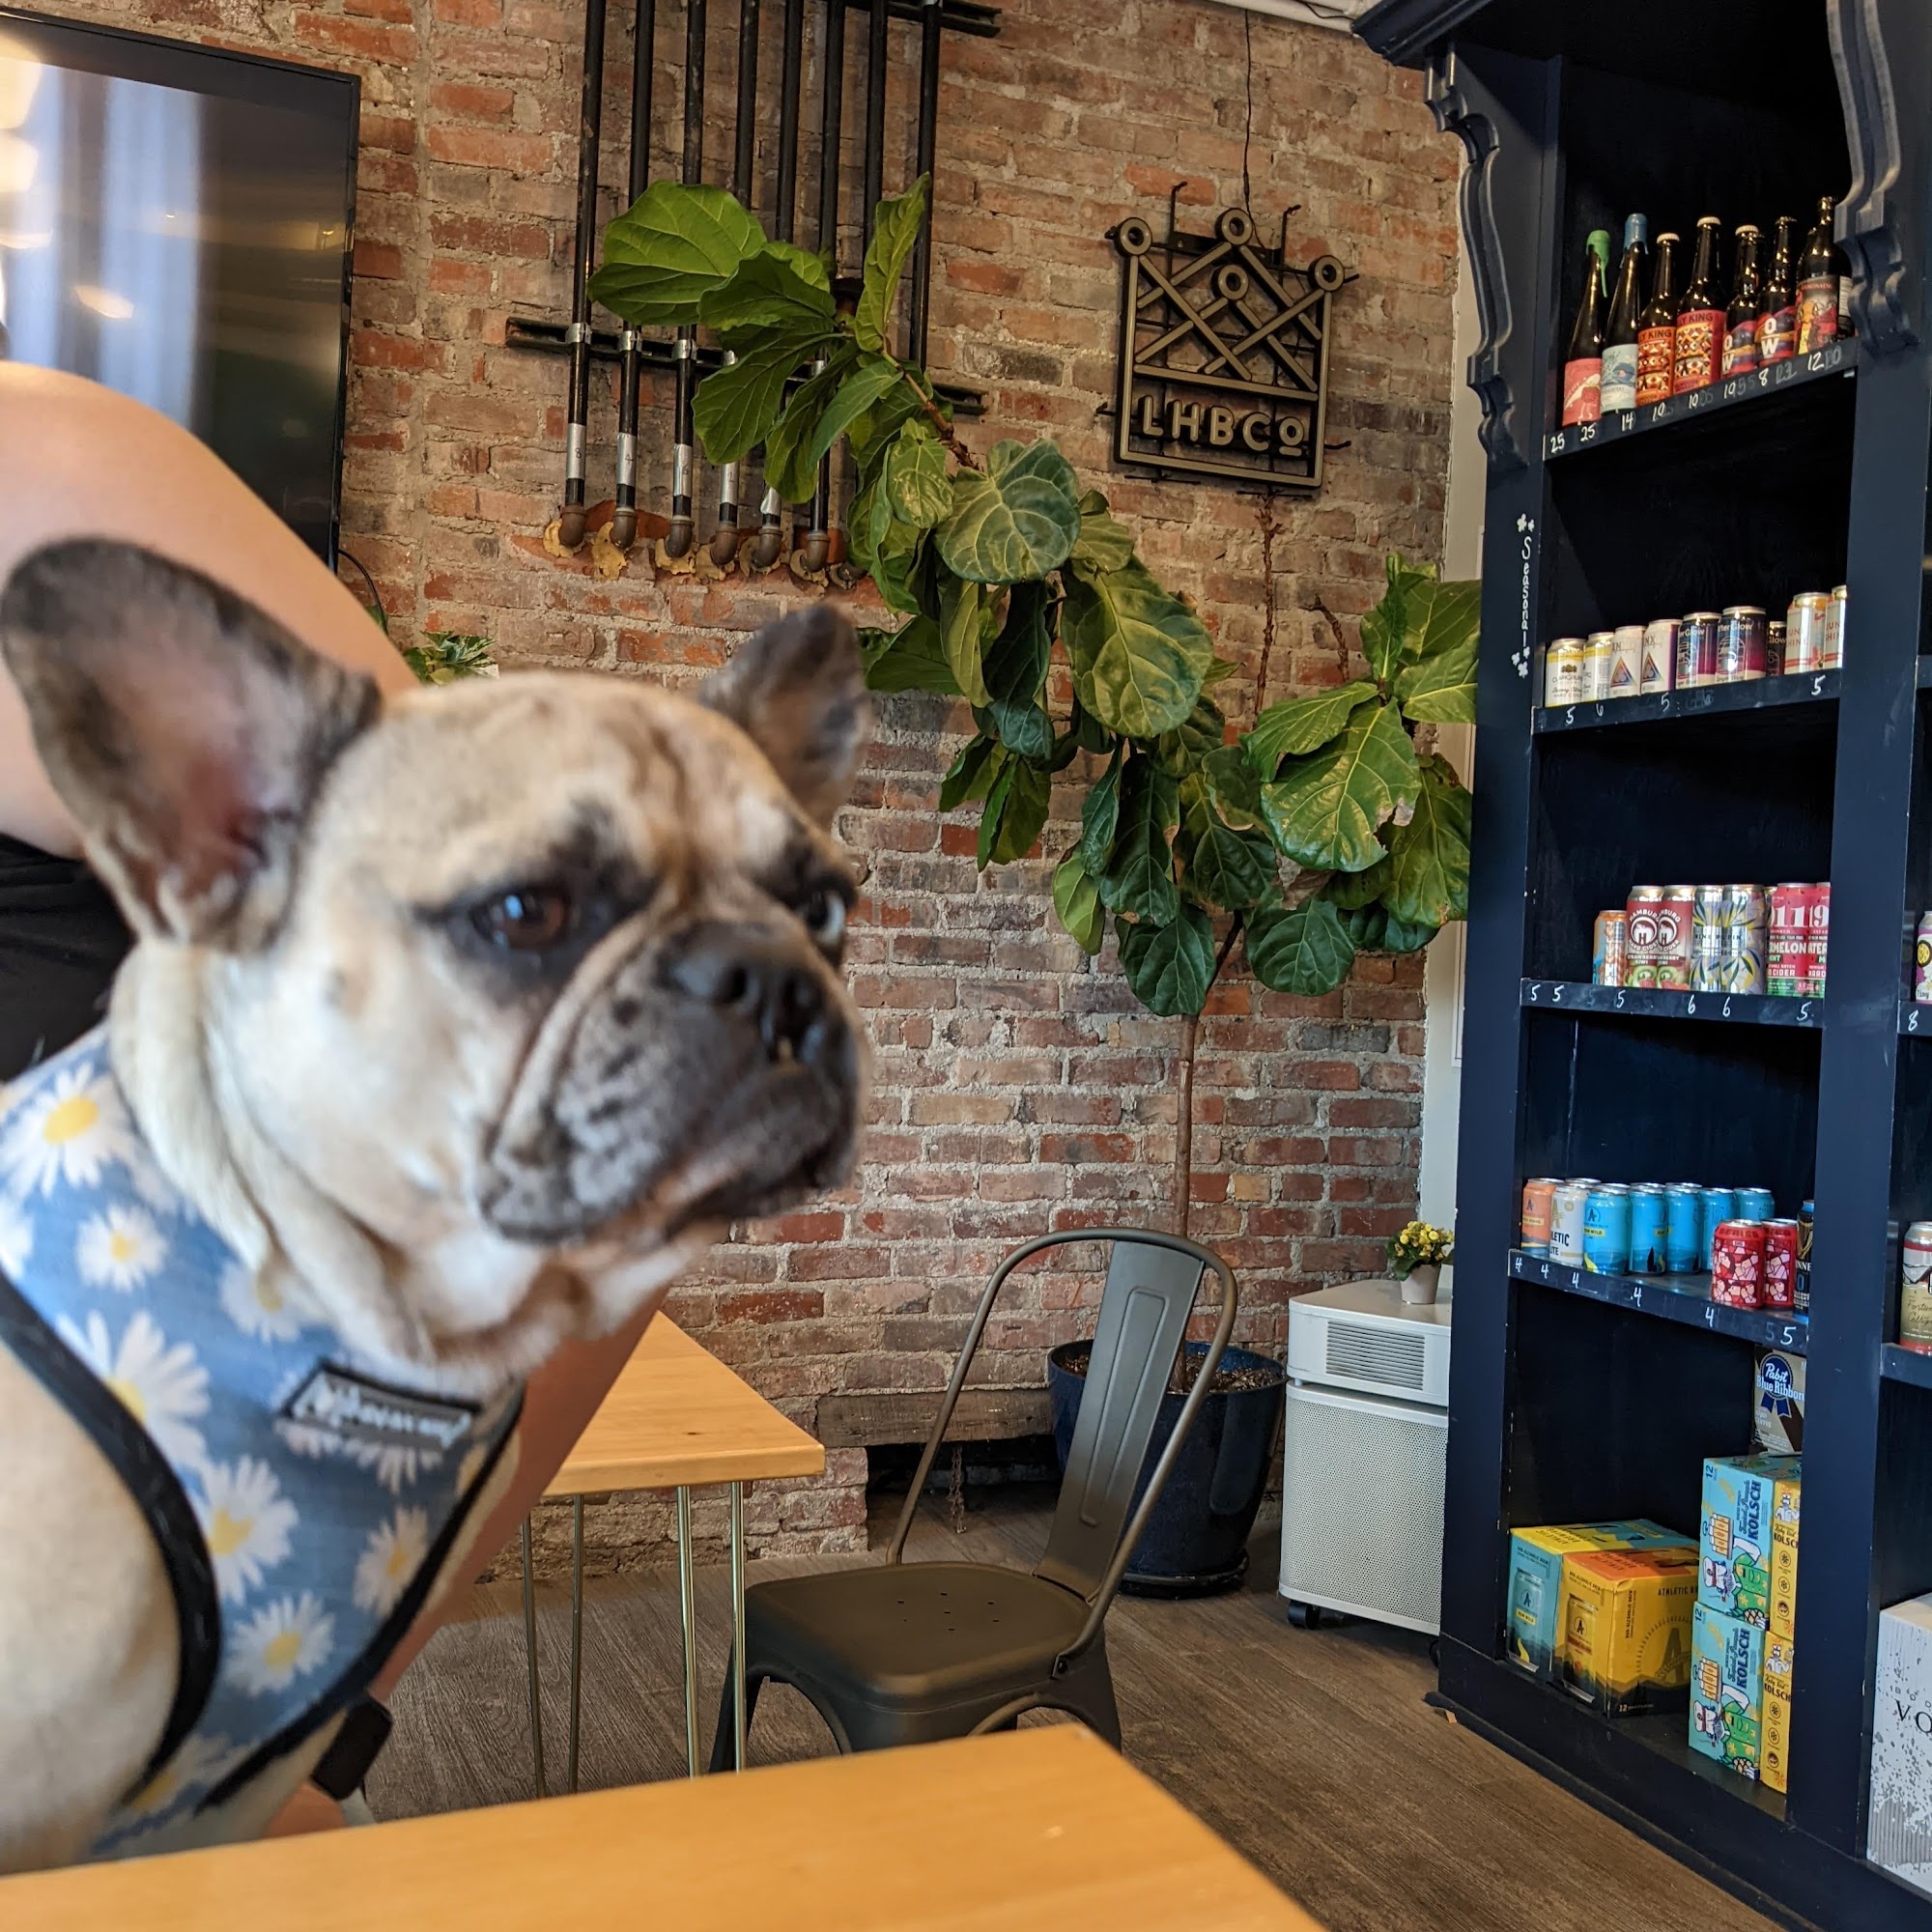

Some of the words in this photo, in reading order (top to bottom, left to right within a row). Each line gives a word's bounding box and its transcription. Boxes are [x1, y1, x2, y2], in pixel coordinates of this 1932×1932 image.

[1689, 313, 1714, 323] KING
[1648, 329, 1672, 339] KING
[1761, 337, 1779, 359] W
[1549, 432, 1565, 454] 25
[1579, 422, 1597, 442] 25
[1621, 412, 1634, 432] 14
[1652, 401, 1665, 422] 10
[1689, 392, 1698, 410] 10
[1758, 367, 1769, 386] 8
[1807, 351, 1825, 371] 12
[1521, 535, 1532, 647] Seasonal
[1565, 705, 1577, 724] 5
[1661, 692, 1670, 712] 5
[1810, 674, 1826, 696] 5
[1663, 939, 1680, 952] CIDER
[1530, 983, 1541, 1002] 5
[1551, 984, 1565, 1003] 5
[1616, 989, 1626, 1009] 5
[1687, 994, 1696, 1015] 6
[1721, 996, 1731, 1018] 6
[1796, 1001, 1812, 1022] 5
[1908, 1009, 1919, 1032] 8
[1541, 1264, 1549, 1279] 4
[1572, 1271, 1579, 1289] 4
[1633, 1287, 1642, 1307] 4
[1705, 1306, 1715, 1327] 4
[1780, 1326, 1797, 1346] 5
[1765, 1362, 1789, 1383] Pabst
[1756, 1375, 1774, 1392] Blue
[1774, 1380, 1804, 1402] Ribbon
[1705, 1464, 1714, 1479] 12
[1747, 1479, 1762, 1541] KOLSCH
[1658, 1586, 1688, 1596] ATHLETIC
[1694, 1608, 1702, 1622] 12
[1736, 1628, 1750, 1690] KOLSCH
